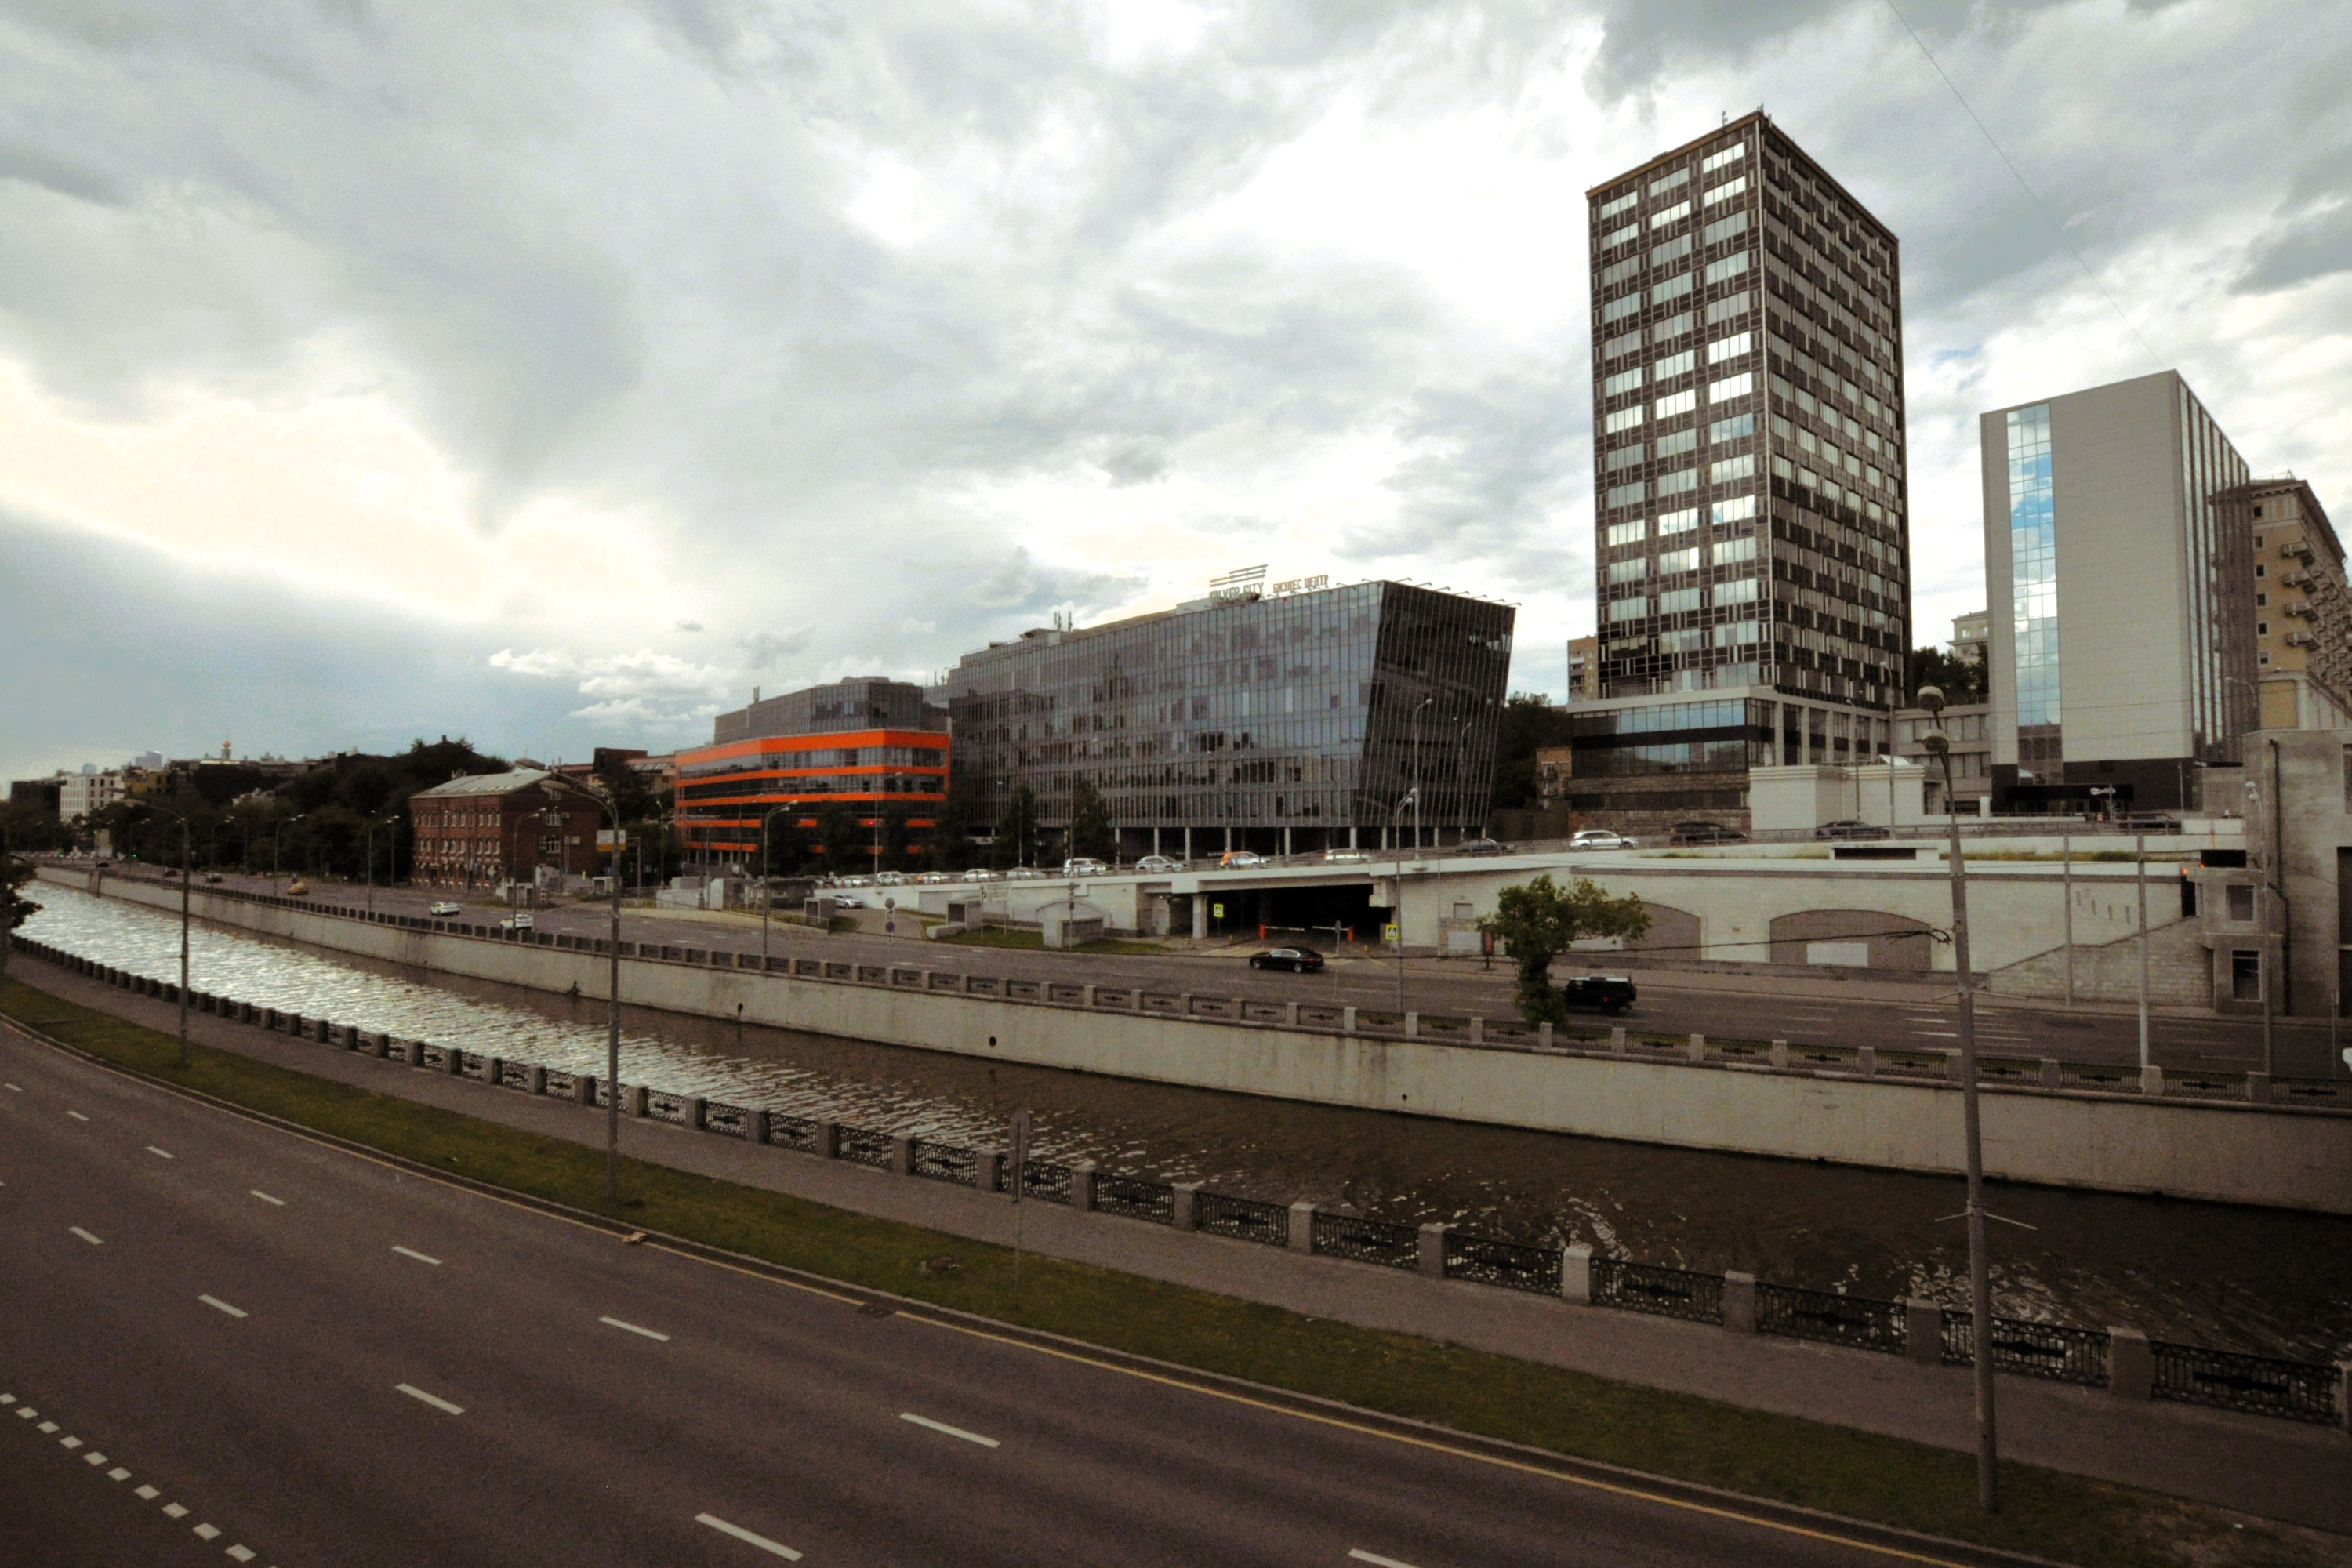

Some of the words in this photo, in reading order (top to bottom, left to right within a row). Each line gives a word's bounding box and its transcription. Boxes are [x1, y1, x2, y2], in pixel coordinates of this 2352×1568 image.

[1210, 587, 1240, 604] SILVER
[1243, 582, 1264, 600] CITY
[1273, 579, 1301, 593] БИЗНЕС
[1305, 574, 1329, 588] ЦЕНТР
